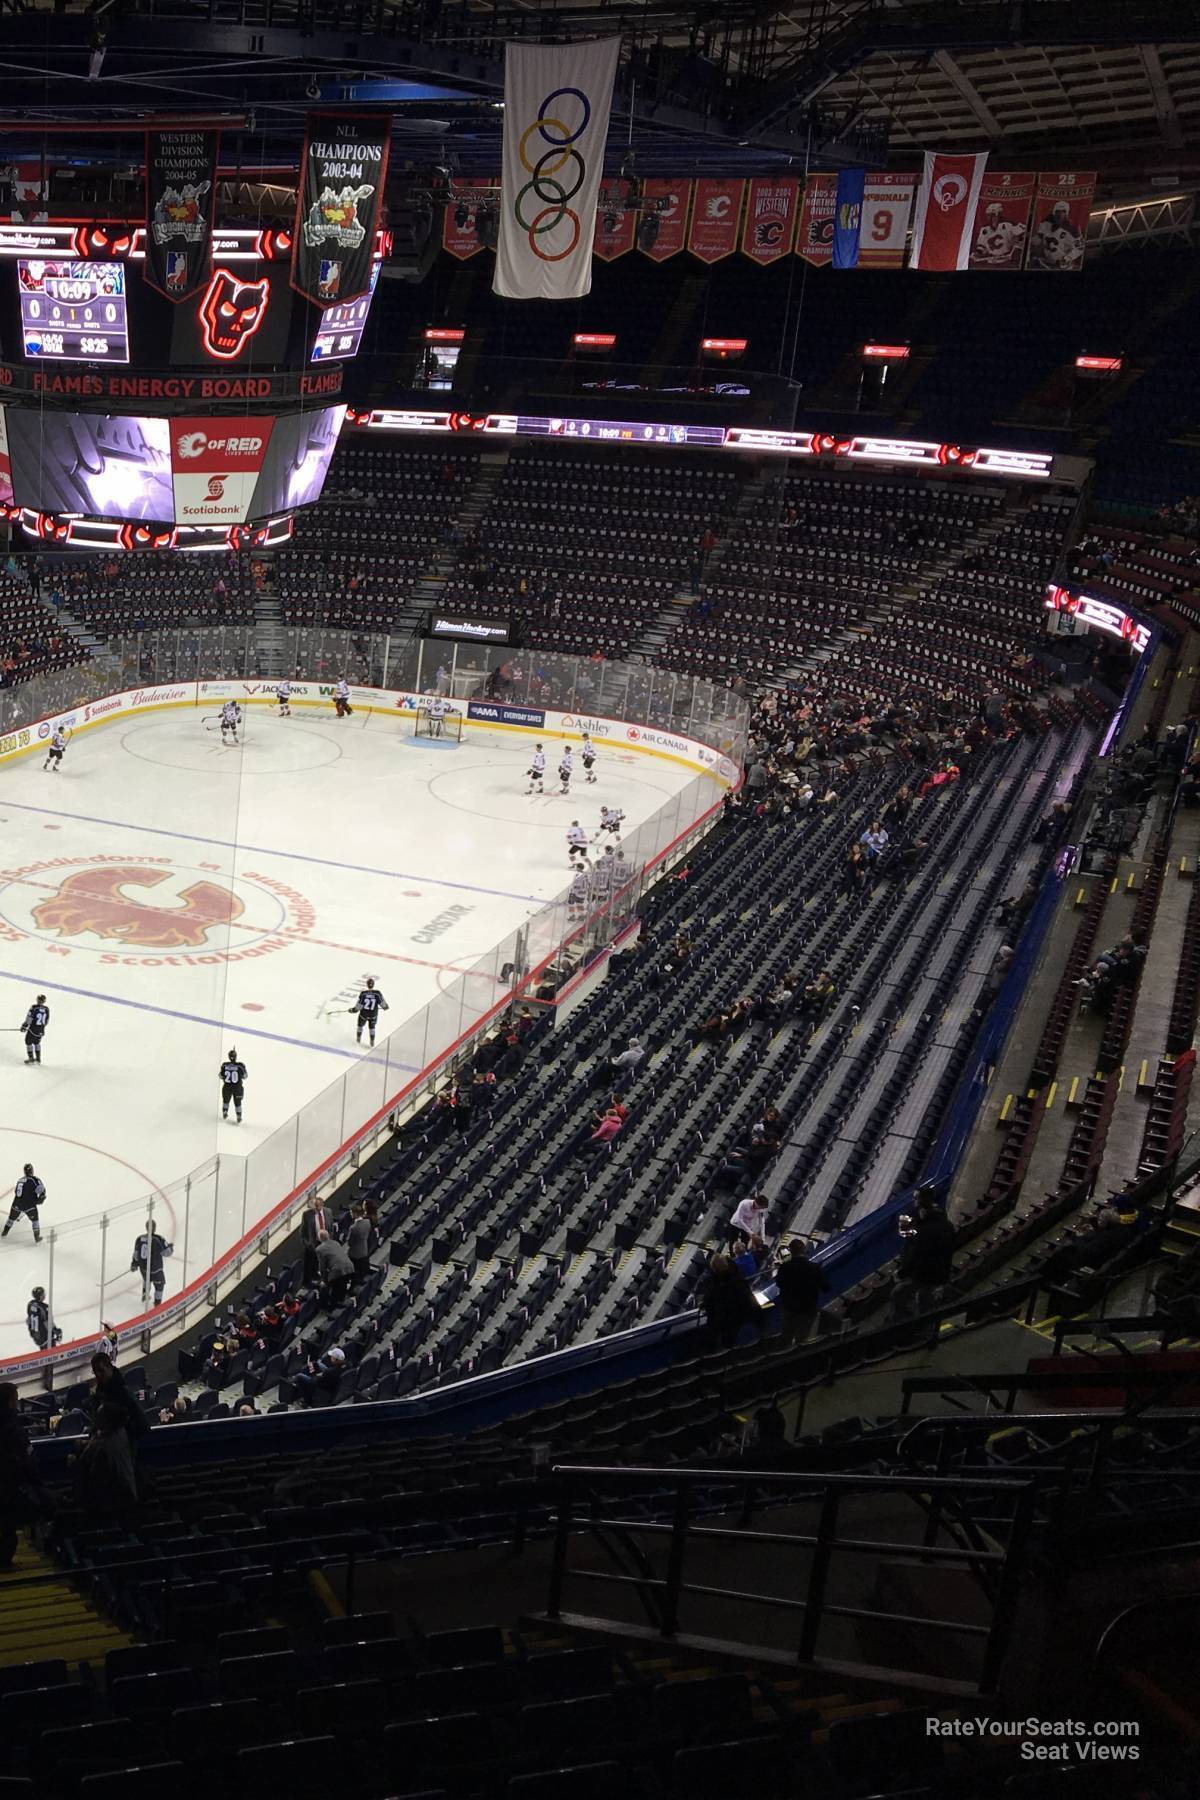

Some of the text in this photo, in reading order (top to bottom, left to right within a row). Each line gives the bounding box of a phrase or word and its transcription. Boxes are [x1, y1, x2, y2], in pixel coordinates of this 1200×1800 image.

[159, 134, 205, 143] WESTERN
[335, 126, 359, 137] NLL
[161, 146, 205, 156] DIVISION
[309, 143, 382, 162] CHAMPIONS
[154, 158, 209, 168] CHAMPIONS
[322, 162, 363, 179] 2003-04
[165, 171, 197, 181] 2004-05
[1003, 176, 1011, 186] 2
[1059, 175, 1075, 186] 25
[810, 207, 836, 215] DIVISI
[872, 210, 893, 241] 9
[52, 281, 91, 299] 10:09
[29, 299, 41, 318] 0
[53, 307, 60, 319] 0
[70, 309, 75, 320] 1
[84, 308, 93, 321] 0
[105, 303, 117, 322] 0
[80, 338, 108, 354] $825
[33, 373, 271, 398] FLAMES ENERGY BOARD
[208, 440, 225, 451] OF
[226, 437, 263, 451] RED
[183, 505, 239, 515] Scotiabank
[435, 620, 507, 636] HitmenHockey.com
[131, 689, 186, 706] Budweiser
[91, 700, 122, 716] Scotiabank
[477, 707, 498, 717] AMA
[575, 718, 611, 734] Ashley
[18, 731, 31, 748] 73
[642, 733, 688, 753] AIR CANADA
[1, 854, 173, 879] Saddledome
[98, 937, 295, 967] Scotiabank
[225, 1071, 238, 1083] 20
